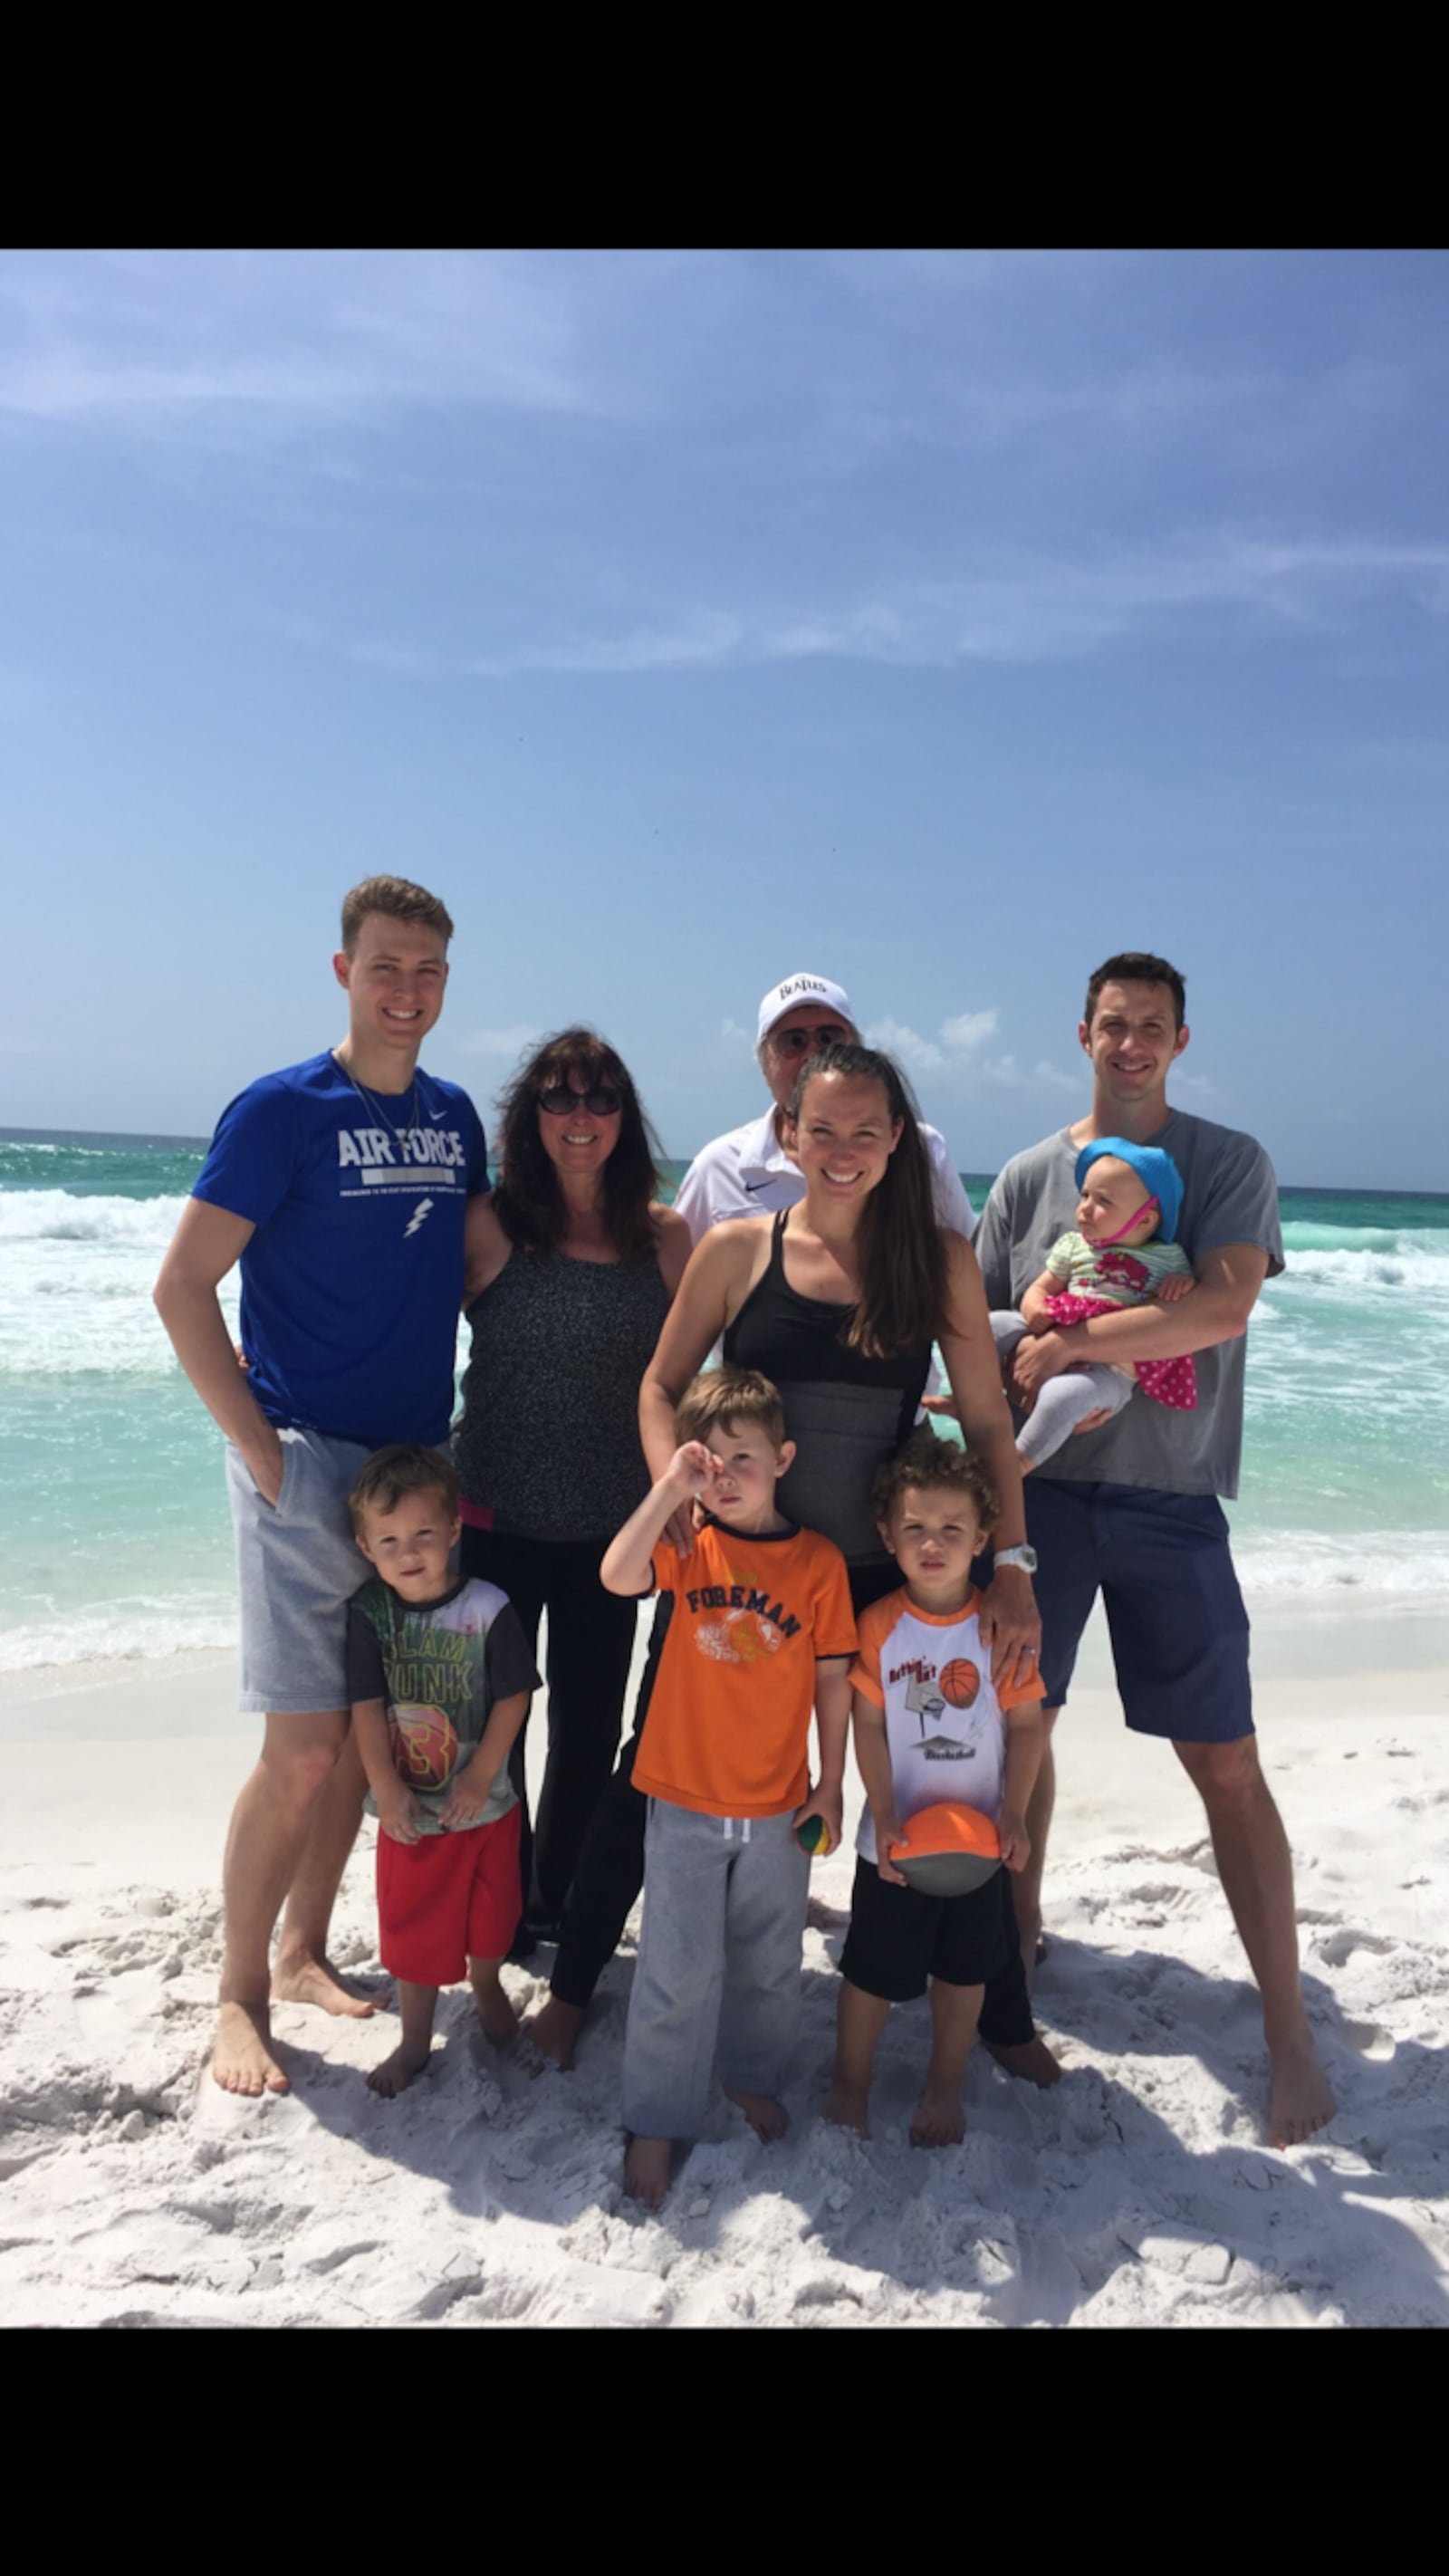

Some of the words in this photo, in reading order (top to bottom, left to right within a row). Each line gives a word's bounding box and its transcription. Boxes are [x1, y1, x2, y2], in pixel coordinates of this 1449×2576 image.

[339, 1129, 396, 1167] AIR
[395, 1128, 465, 1166] FORCE
[686, 1585, 801, 1639] FOREMAN
